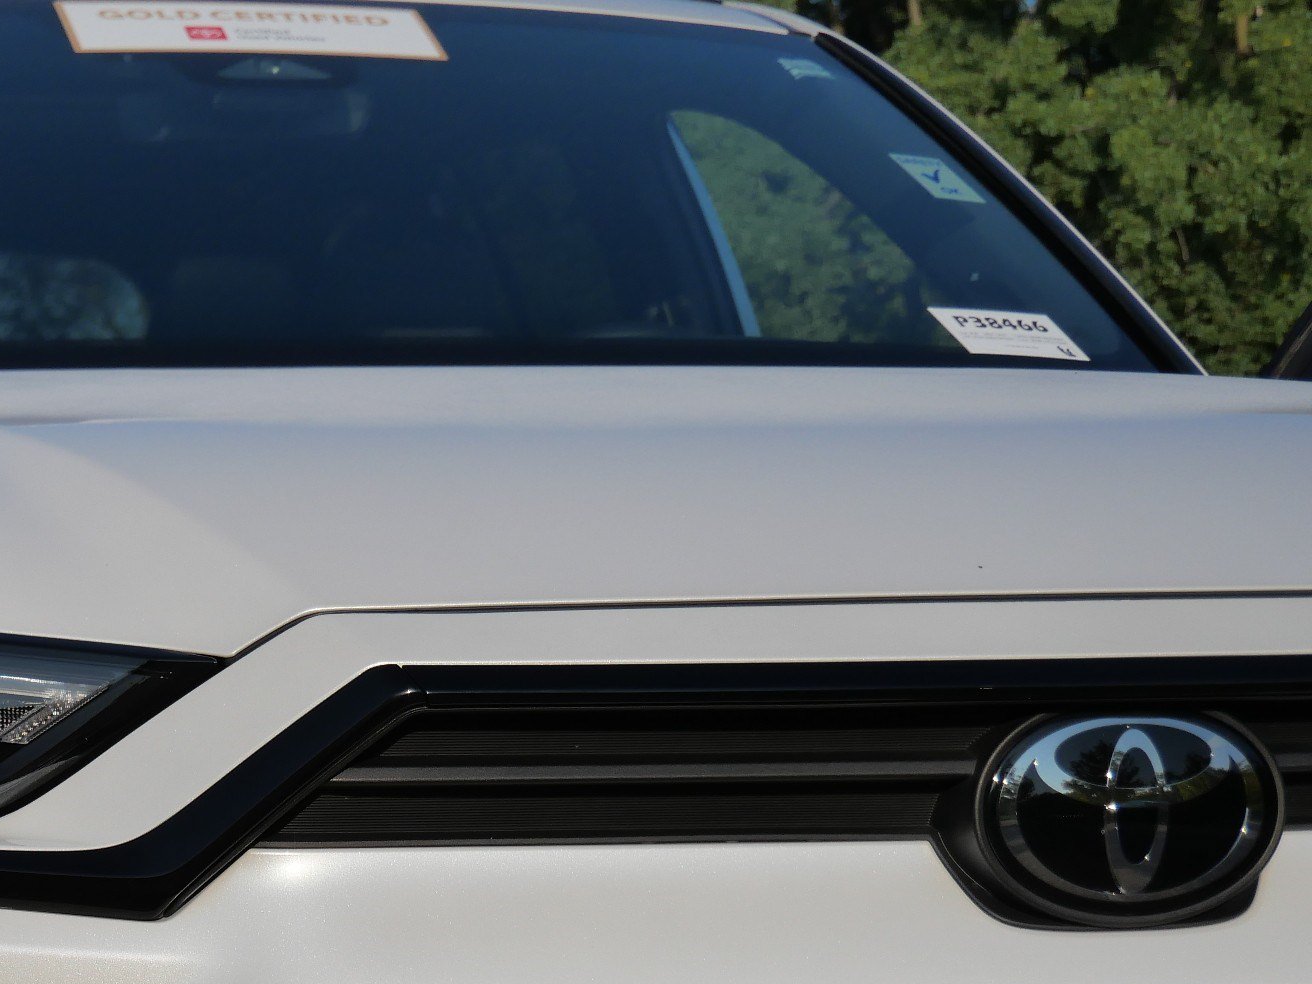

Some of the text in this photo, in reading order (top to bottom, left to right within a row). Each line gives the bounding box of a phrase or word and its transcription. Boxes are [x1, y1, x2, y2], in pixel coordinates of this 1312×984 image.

[97, 9, 390, 26] GOLD CERTIFIED
[952, 315, 1048, 333] P38466
